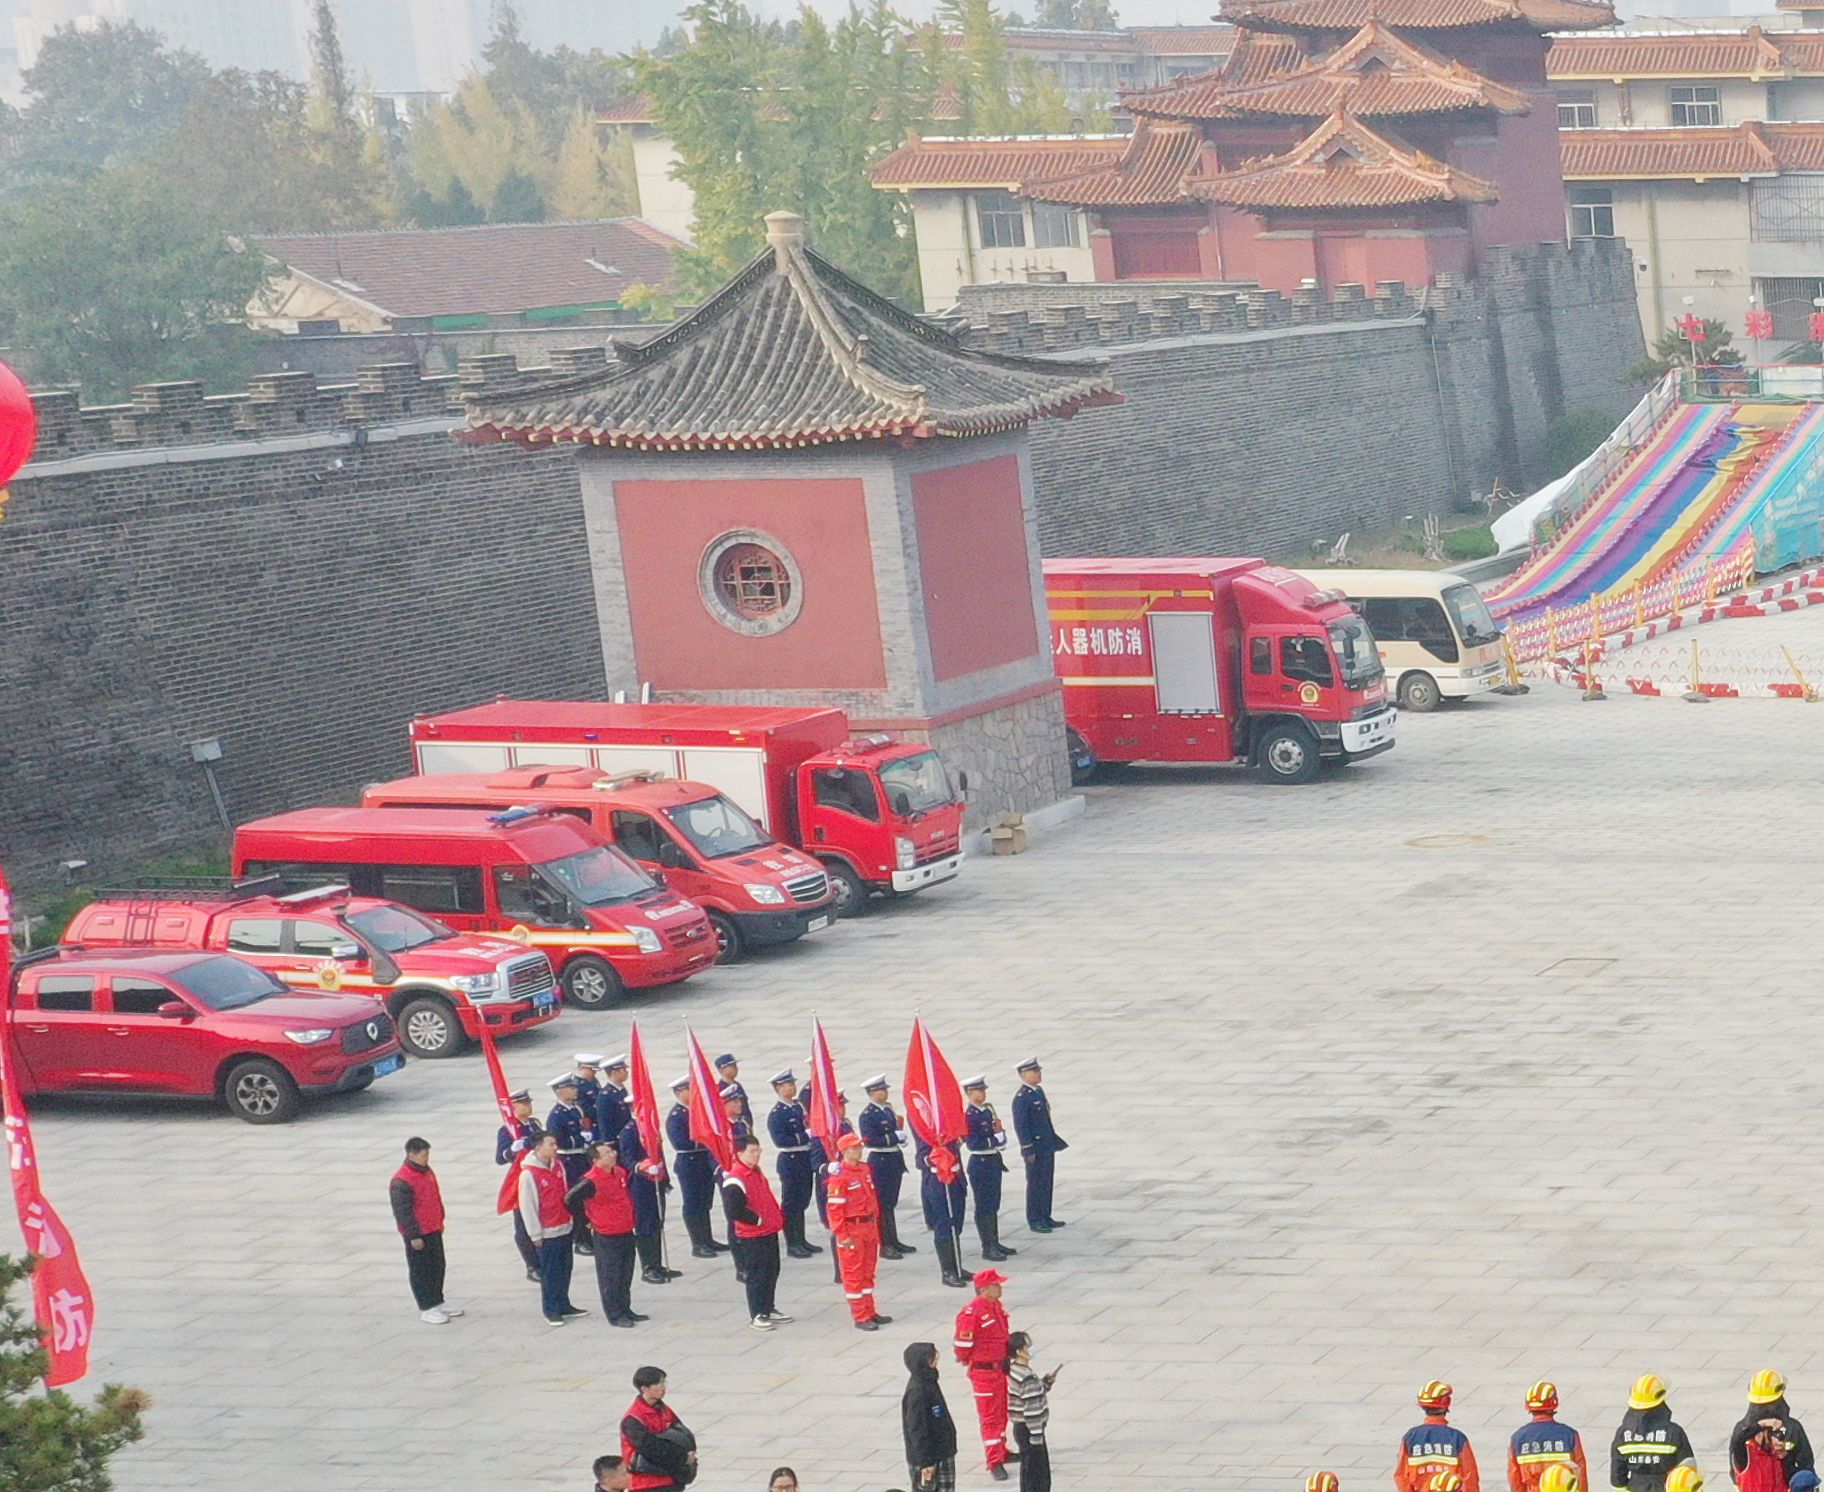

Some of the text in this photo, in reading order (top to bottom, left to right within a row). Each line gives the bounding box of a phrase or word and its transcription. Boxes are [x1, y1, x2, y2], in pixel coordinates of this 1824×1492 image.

[1412, 1443, 1452, 1457] 应急消防
[1521, 1440, 1563, 1454] 应急消防
